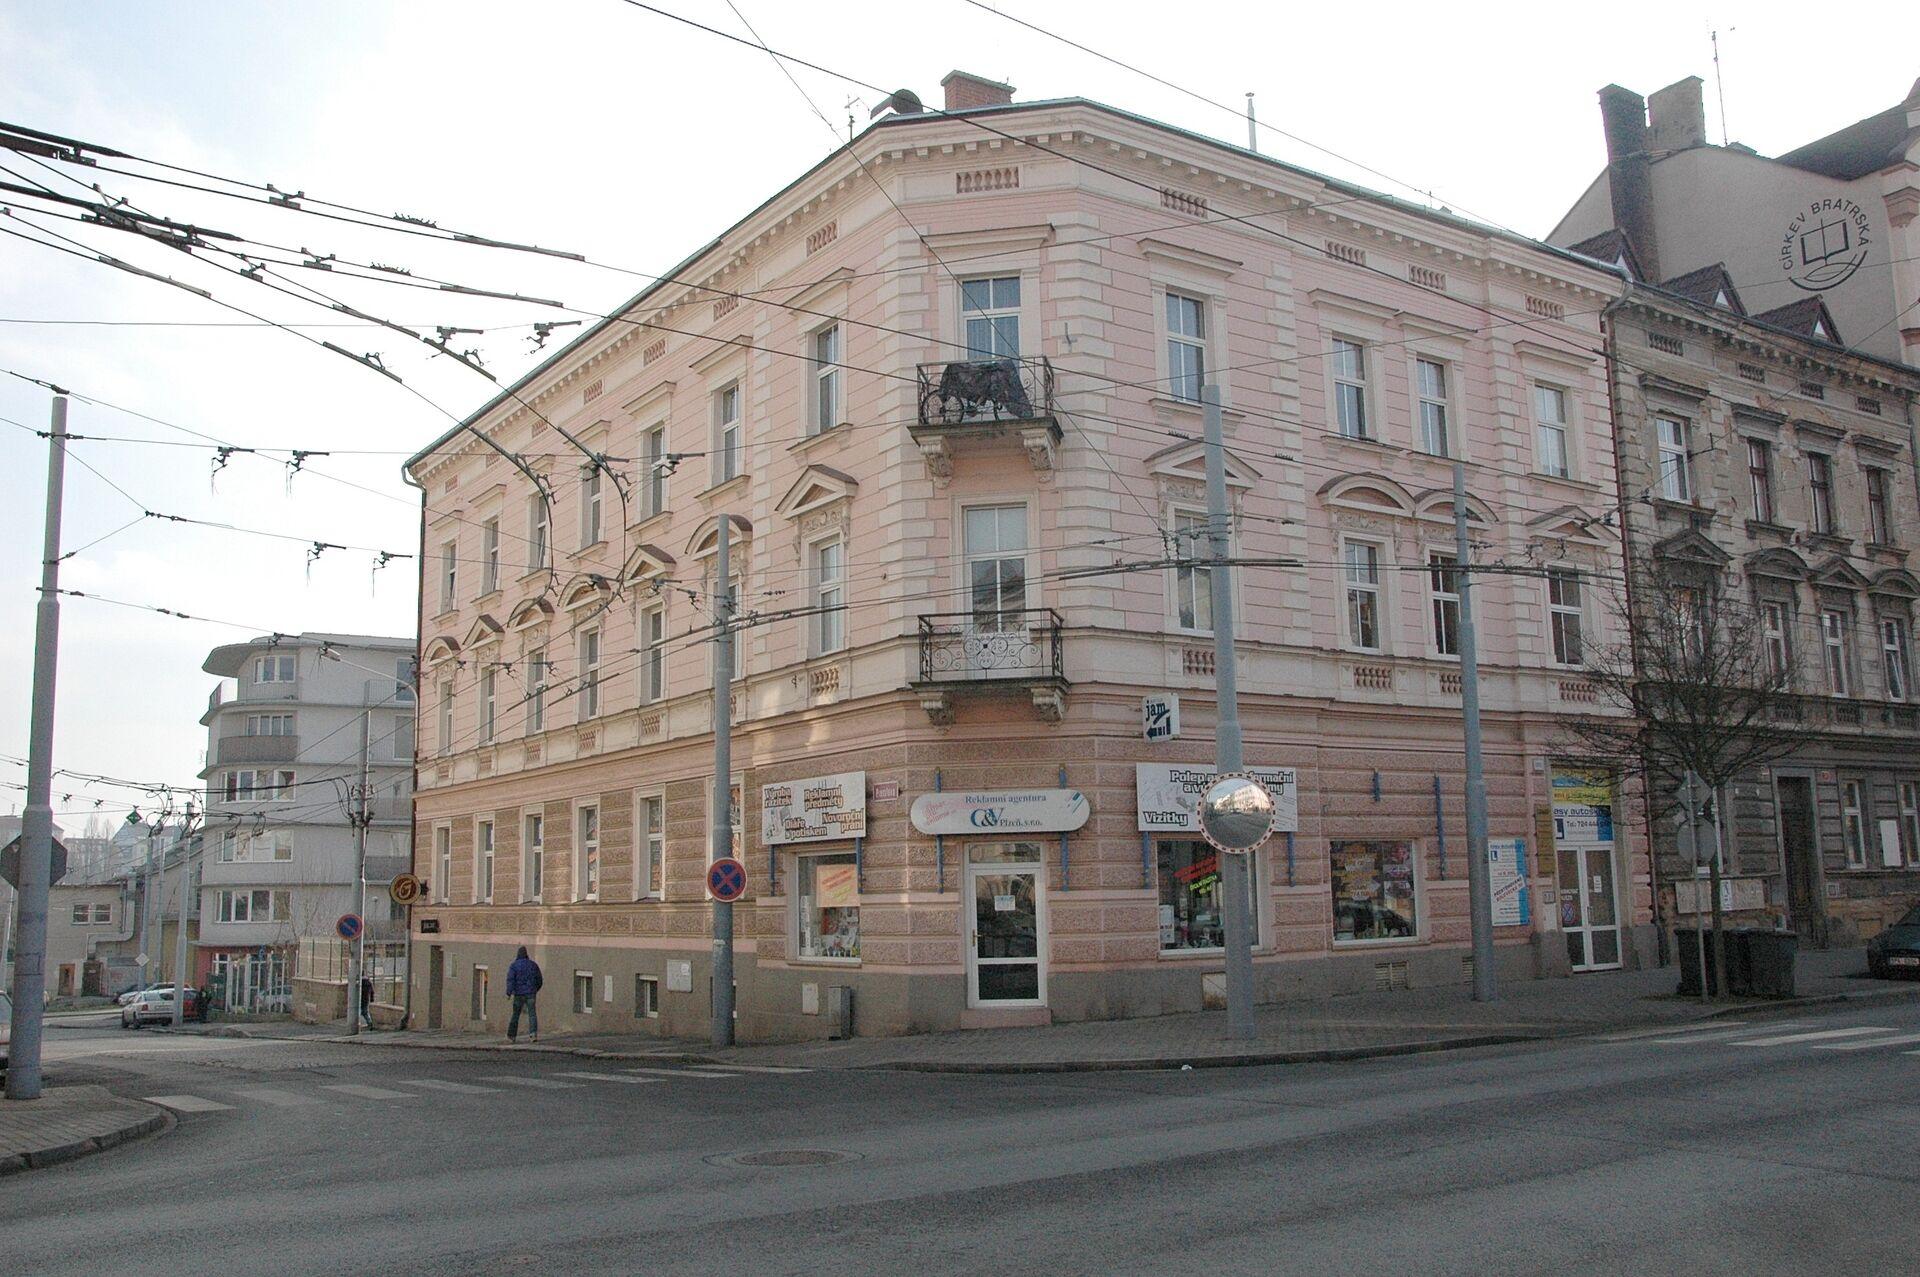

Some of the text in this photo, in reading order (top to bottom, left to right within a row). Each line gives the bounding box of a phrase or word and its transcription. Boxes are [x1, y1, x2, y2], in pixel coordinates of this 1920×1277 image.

[1779, 199, 1872, 270] CÍRKEV BRATRSKÁ
[1170, 770, 1206, 785] Polep
[804, 784, 843, 801] Reklamní
[965, 794, 1006, 804] Reklamní
[1008, 794, 1047, 804] agentura
[804, 796, 844, 812] předměty
[822, 808, 865, 824] Novoroční
[1143, 811, 1189, 826] Vizitky
[791, 826, 827, 840] potiskem
